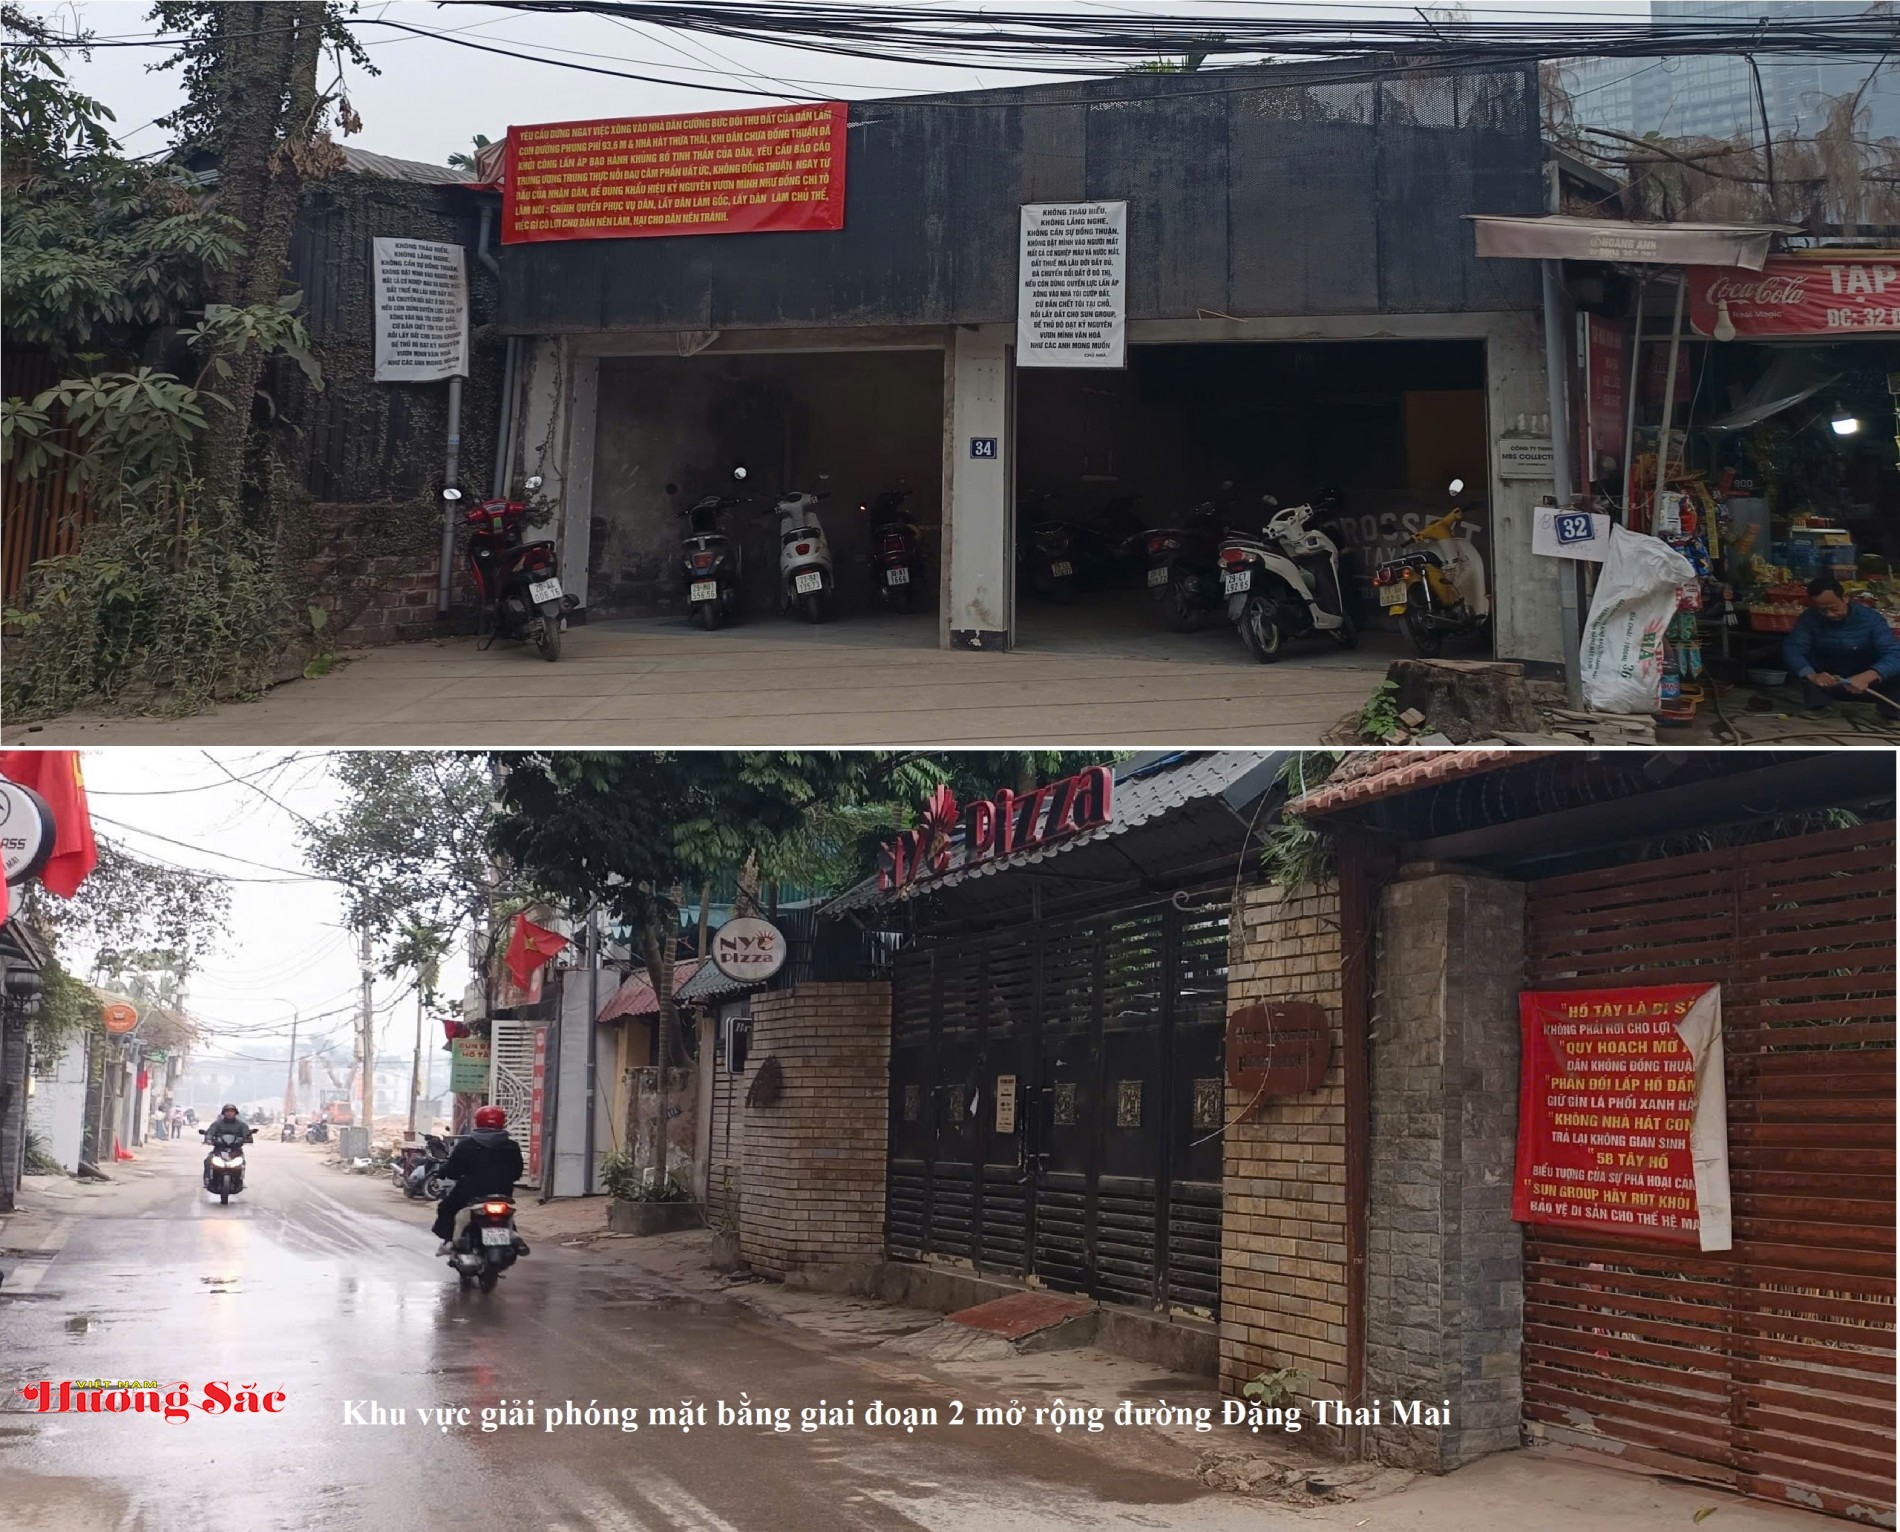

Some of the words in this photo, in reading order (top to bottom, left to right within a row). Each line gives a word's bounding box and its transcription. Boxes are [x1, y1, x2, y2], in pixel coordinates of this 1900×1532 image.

[672, 150, 690, 161] TINH
[1706, 276, 1808, 305] Coca-Cola
[1823, 265, 1896, 303] TẠP
[1756, 310, 1782, 318] Magic
[1864, 307, 1886, 326] 32
[976, 441, 991, 455] 34
[1563, 517, 1587, 538] 32
[1639, 632, 1656, 660] BIA
[720, 930, 775, 951] NYC
[1594, 1004, 1622, 1017] TÂY
[1628, 1001, 1647, 1016] LÀ
[1544, 1023, 1577, 1035] KHÔNG
[1628, 1023, 1649, 1033] CHO
[1653, 1022, 1670, 1036] LỢI
[1598, 1041, 1647, 1056] HOẠCH
[1567, 1058, 1588, 1071] DÂN
[1591, 1059, 1626, 1072] KHÔNG
[1591, 1095, 1604, 1108] LÁ
[1640, 1098, 1675, 1110] XANH
[1602, 1114, 1629, 1129] NHÀ
[1635, 1115, 1661, 1130] HÁT
[1552, 1128, 1570, 1143] TRẢ
[1573, 1134, 1587, 1147] LẠI
[1591, 1134, 1625, 1146] KHÔNG
[1629, 1136, 1655, 1148] GIAN
[1659, 1138, 1685, 1149] SINH
[1618, 1152, 1644, 1167] TÂY
[1649, 1152, 1668, 1169] HỒ
[1588, 1167, 1605, 1183] CỦA
[1609, 1172, 1623, 1186] SỰ
[1625, 1173, 1644, 1186] PHÁ
[1647, 1176, 1671, 1192] HOẠI
[1560, 1186, 1599, 1200] GROUP
[1603, 1188, 1627, 1203] HÃY
[1632, 1190, 1655, 1206] RÚT
[1659, 1192, 1690, 1211] KHỎI
[1530, 1198, 1552, 1212] BẢO
[1556, 1202, 1568, 1217] VỆ
[1572, 1205, 1581, 1216] DI
[1585, 1203, 1607, 1219] SẢN
[1611, 1210, 1633, 1222] CHO
[1637, 1210, 1658, 1225] THẾ
[1662, 1215, 1677, 1230] HỆ
